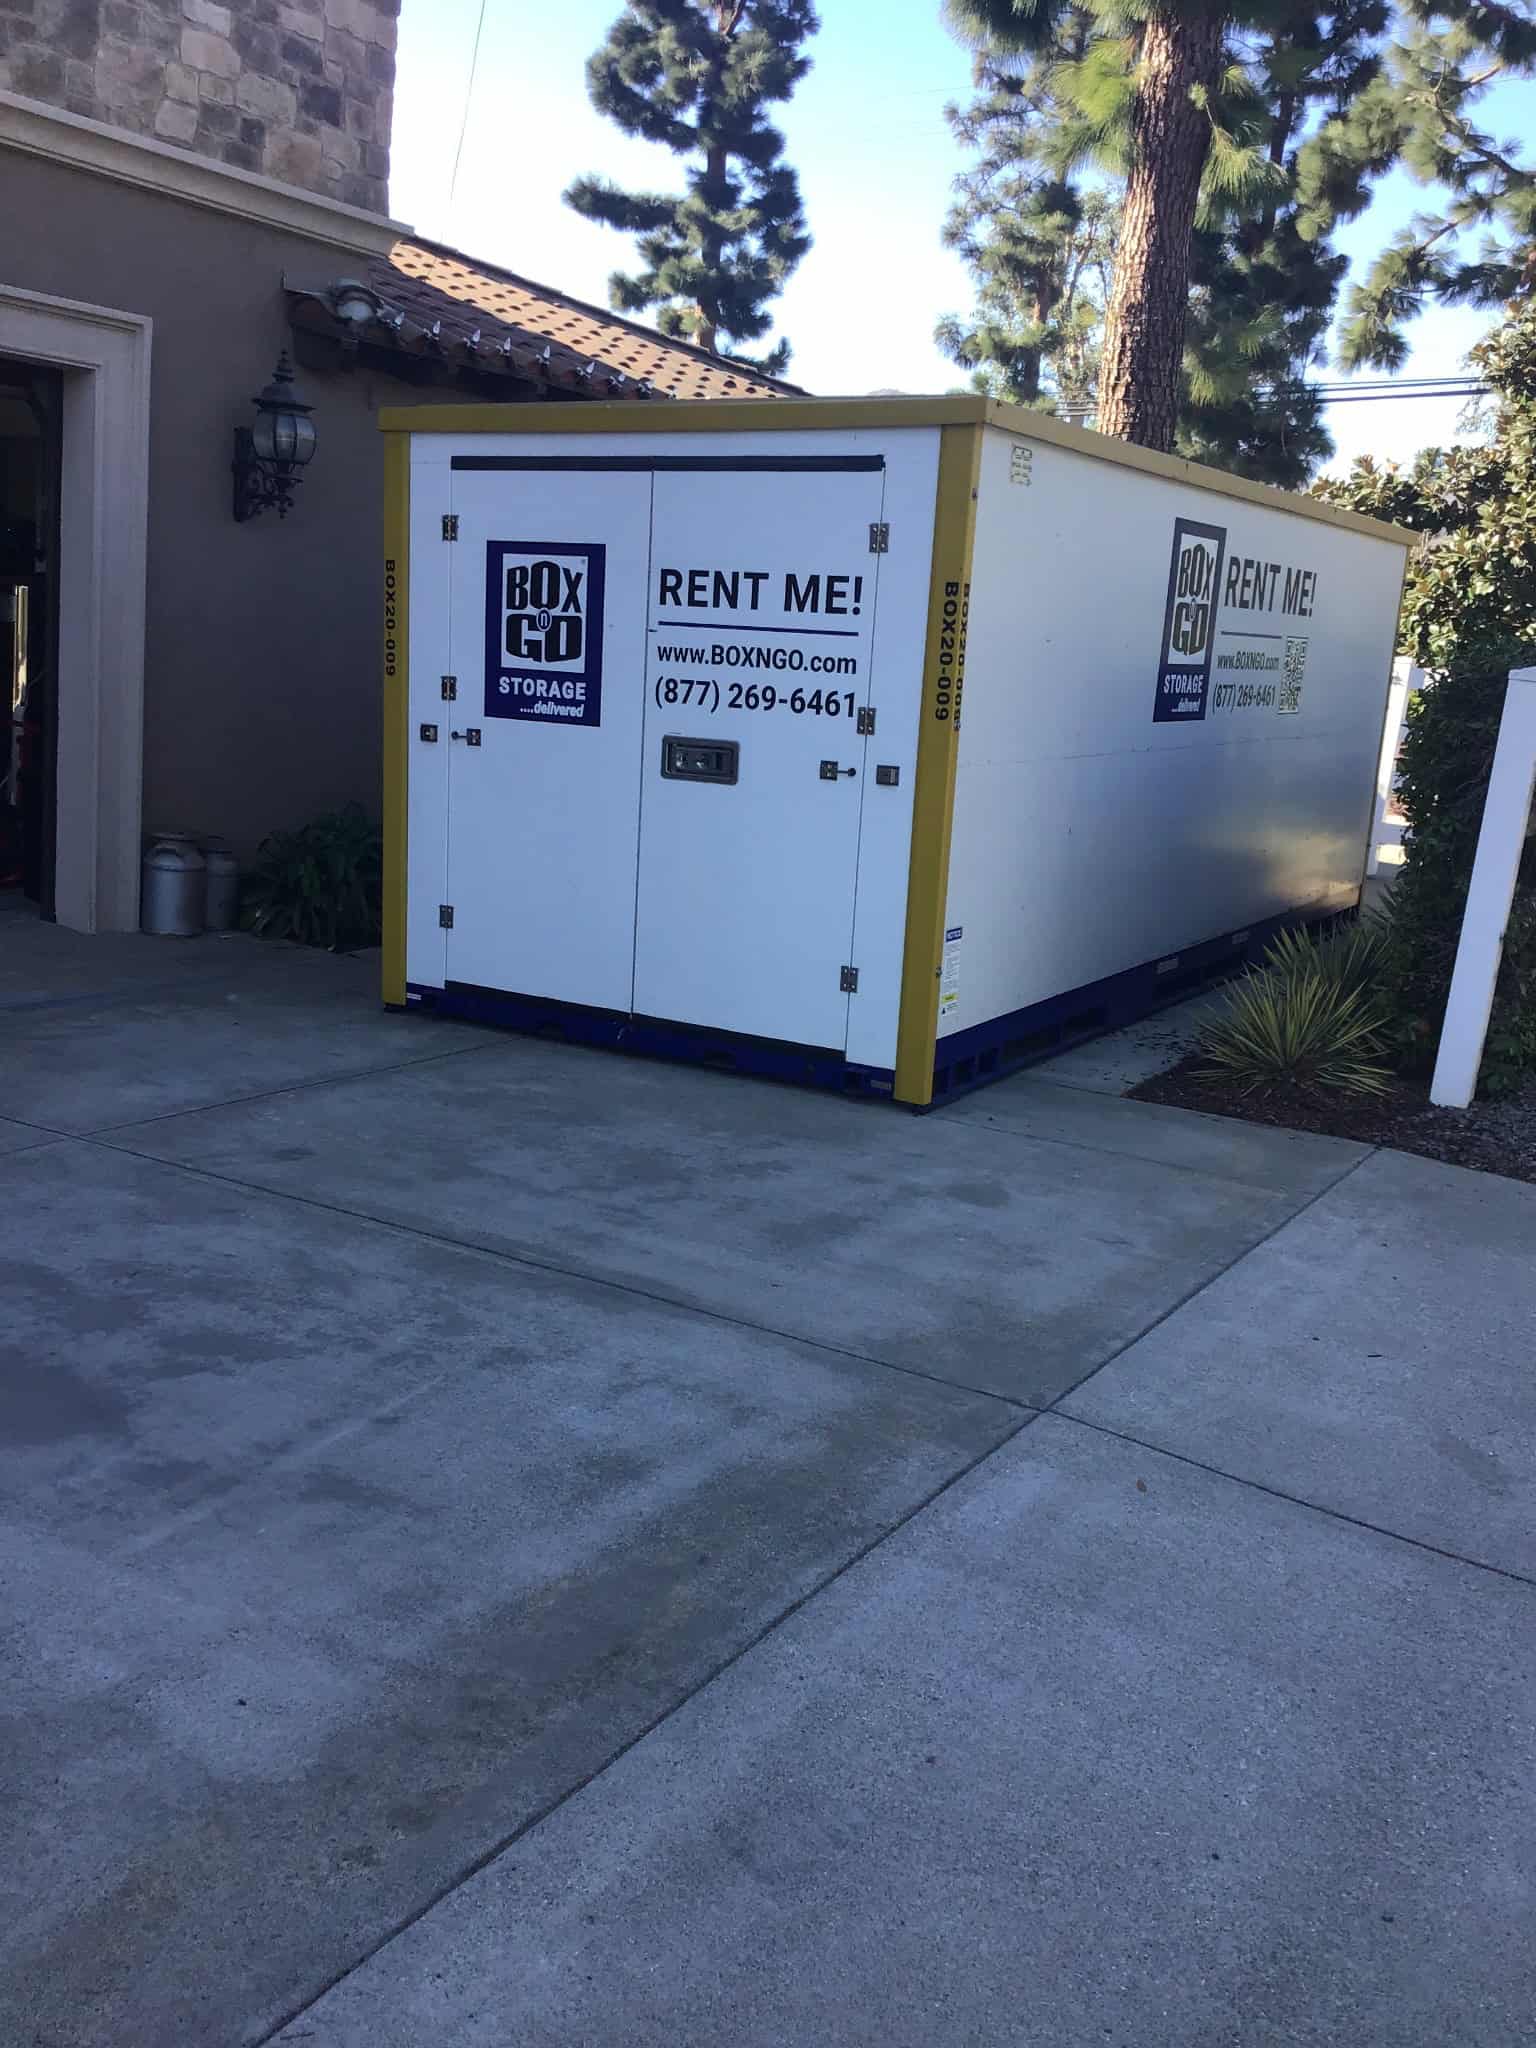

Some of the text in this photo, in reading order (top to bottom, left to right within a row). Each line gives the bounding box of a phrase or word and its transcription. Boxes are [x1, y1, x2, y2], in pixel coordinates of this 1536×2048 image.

[506, 560, 584, 613] BOX
[659, 568, 863, 616] RENT ME!
[1177, 543, 1215, 601] BOX
[1224, 555, 1281, 612] RENT
[1282, 567, 1317, 617] ME!
[385, 559, 396, 676] BOX20-009
[506, 613, 583, 663] GO
[1172, 601, 1209, 656] GO
[657, 644, 857, 674] www.BOXNGO.com
[935, 581, 960, 721] BOX20-009
[1216, 650, 1279, 672] www.BOXNGO.com
[499, 676, 587, 700] STORAGE
[655, 676, 856, 718] (877) 269-6461
[1163, 674, 1204, 694] STORAGE
[1212, 683, 1236, 715] (877)
[1237, 684, 1276, 708] 269-6461
